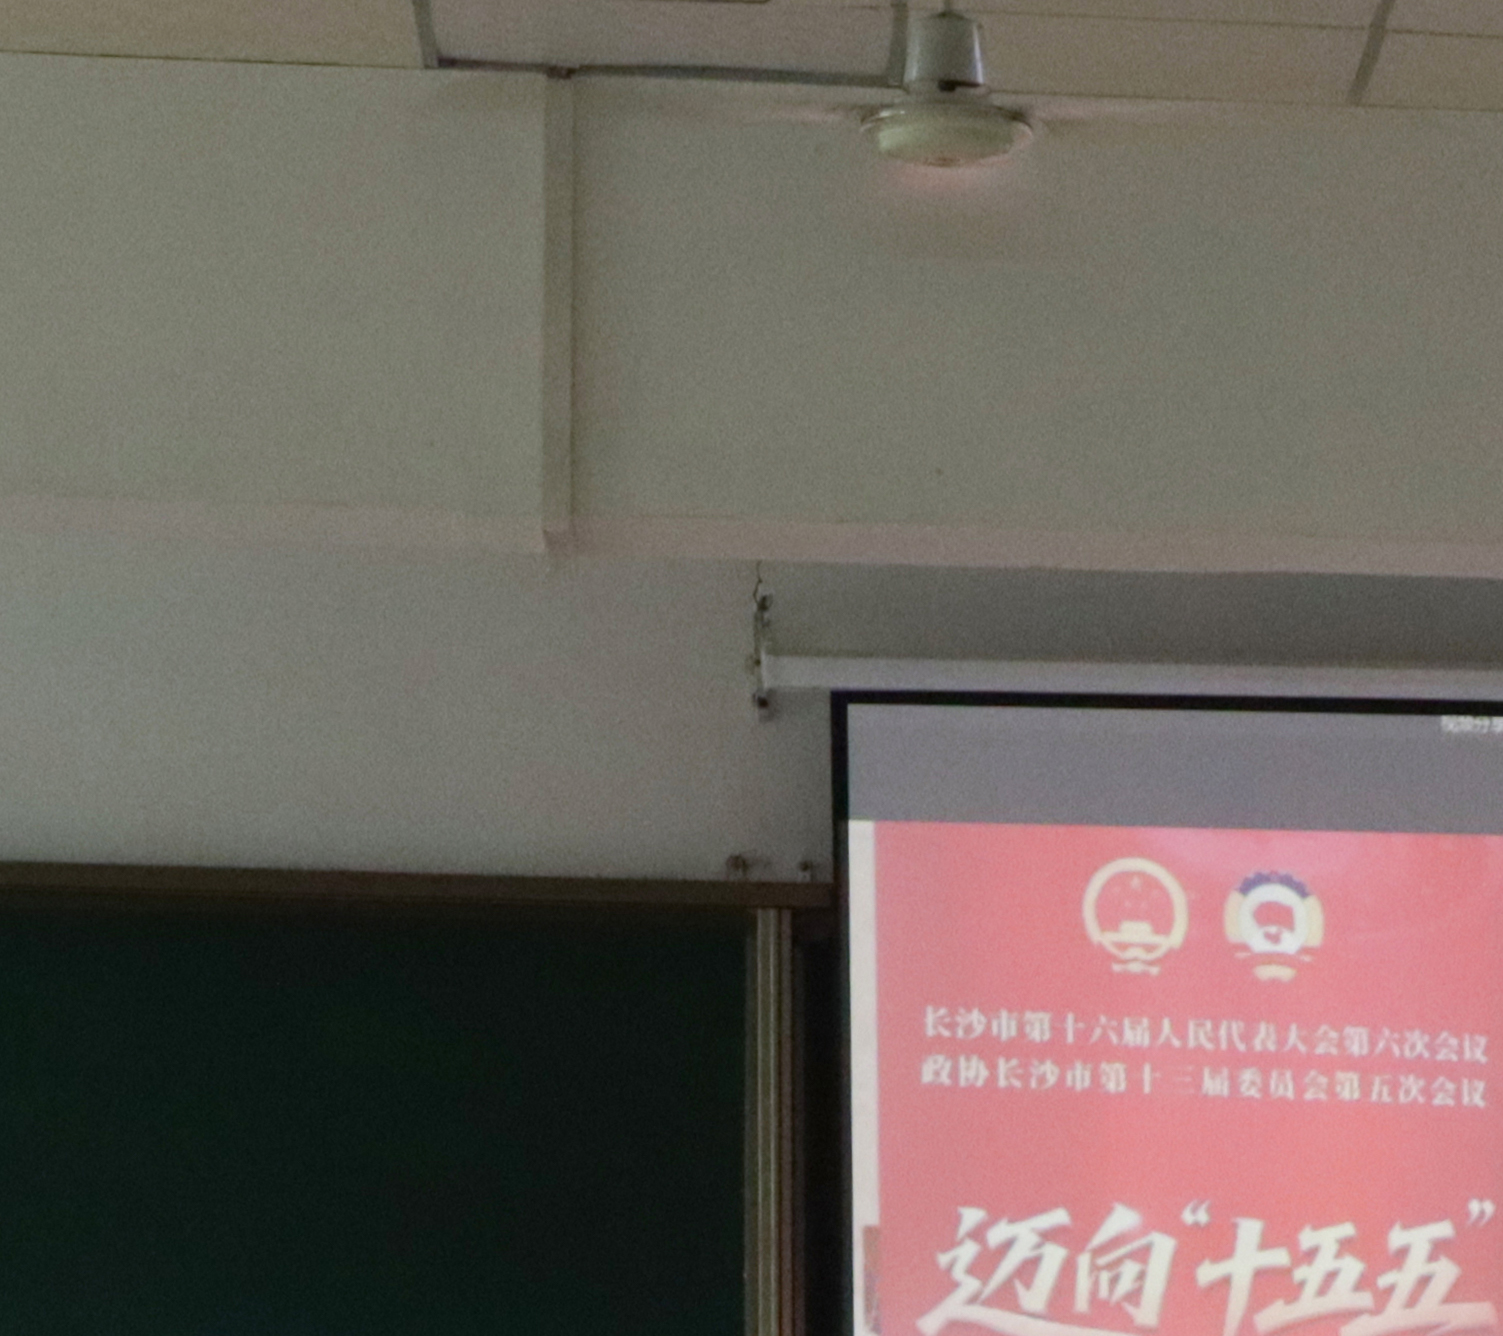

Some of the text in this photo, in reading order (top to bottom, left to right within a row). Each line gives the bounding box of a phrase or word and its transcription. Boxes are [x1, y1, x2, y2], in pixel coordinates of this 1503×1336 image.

[923, 1004, 1489, 1065] 长沙市第十六届人民代表大会第六次会议
[920, 1053, 1488, 1109] 政协长沙市第十三届委员会第五次会议
